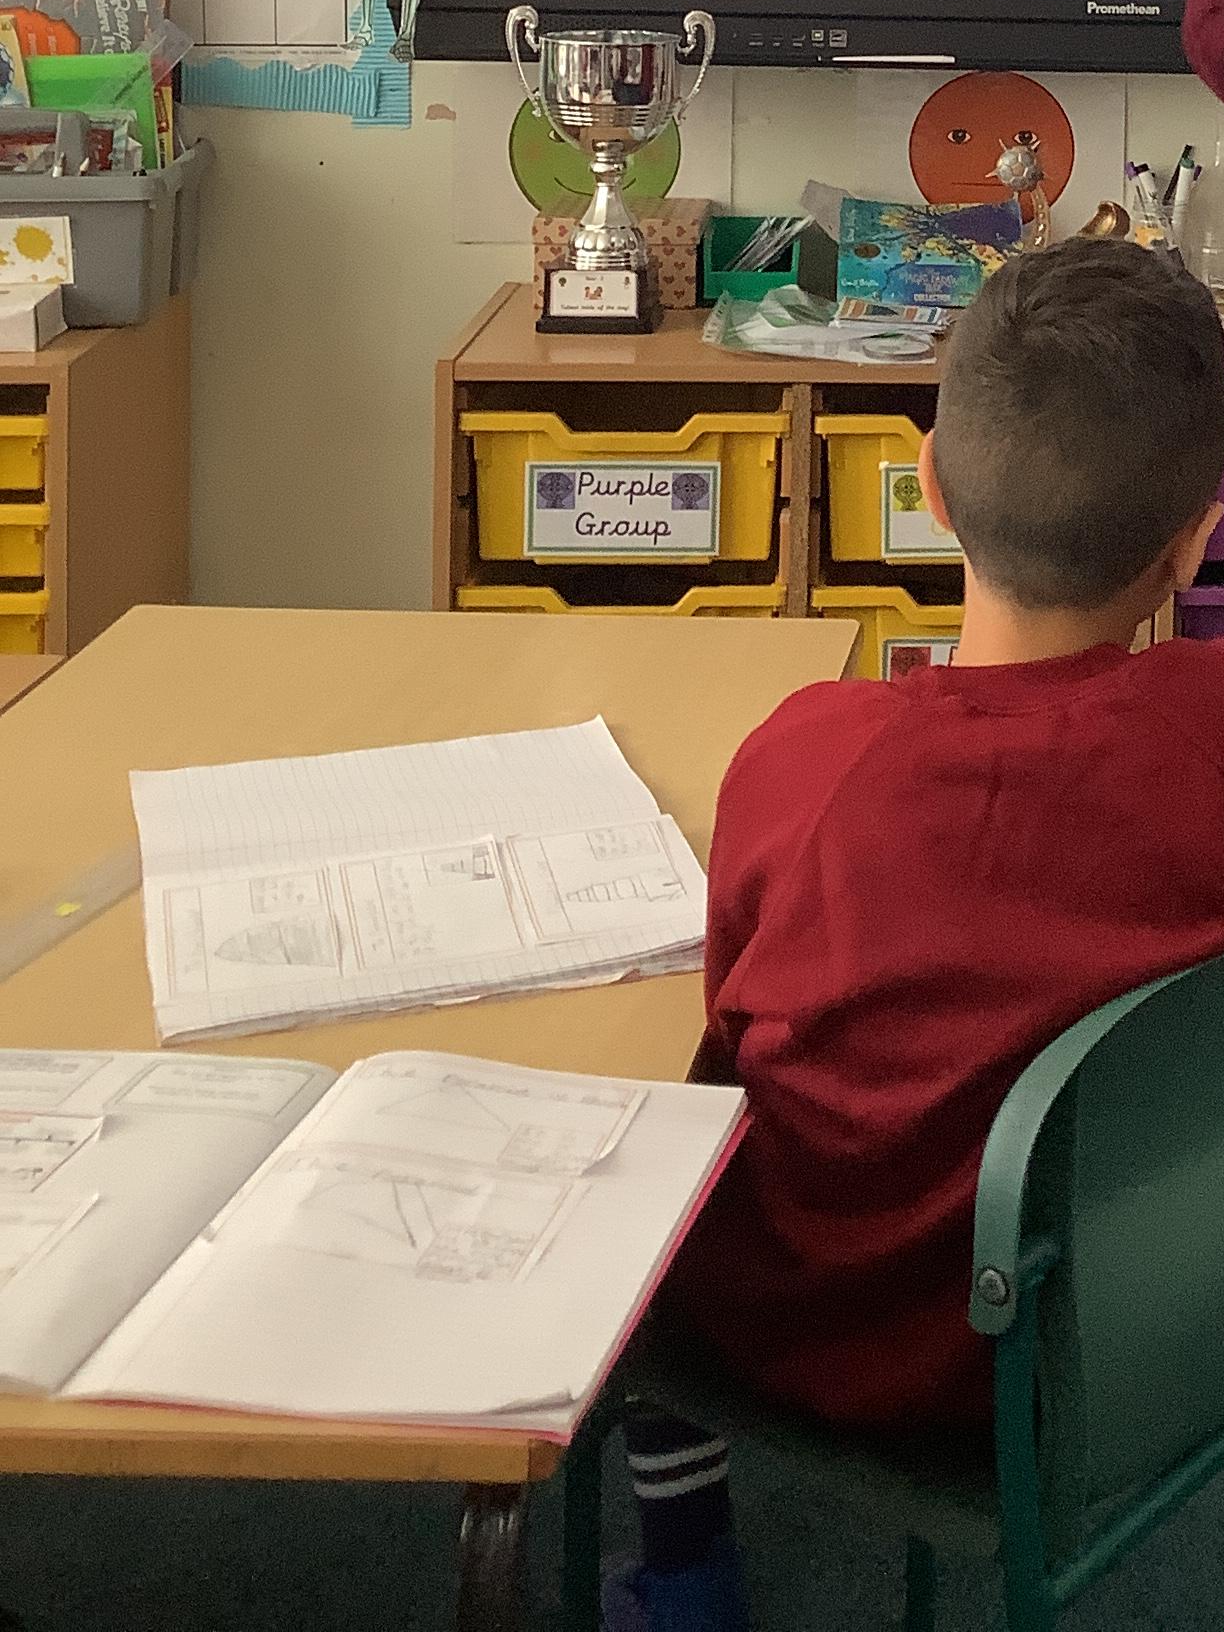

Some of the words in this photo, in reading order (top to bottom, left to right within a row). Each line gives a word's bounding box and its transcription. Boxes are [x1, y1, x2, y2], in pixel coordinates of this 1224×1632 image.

[1087, 1, 1160, 16] Promethean
[577, 472, 670, 500] Purple
[575, 515, 671, 544] Group
